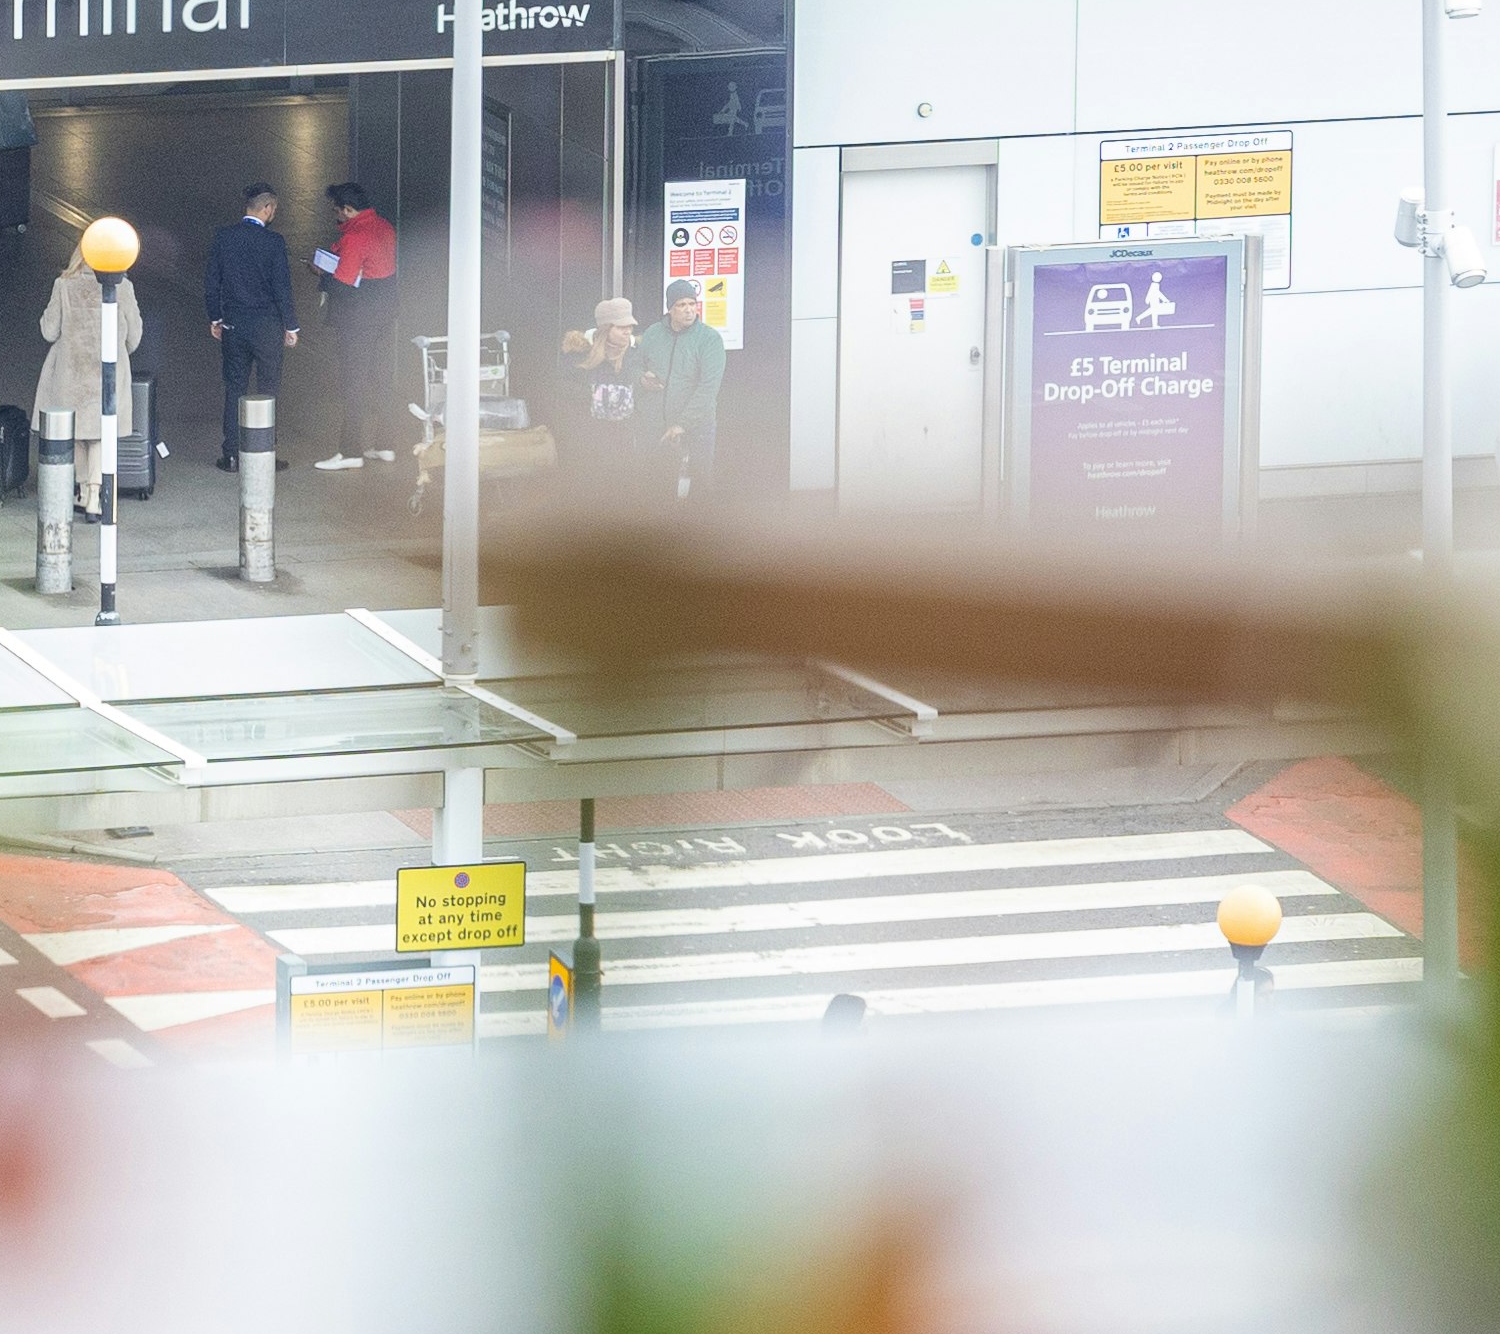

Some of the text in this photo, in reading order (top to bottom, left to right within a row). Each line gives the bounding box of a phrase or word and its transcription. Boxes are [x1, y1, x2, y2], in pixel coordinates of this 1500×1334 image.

[1125, 137, 1268, 153] Terminal 2 Passenger Drop Off
[1146, 164, 1160, 172] per
[1163, 161, 1182, 169] visit
[1109, 249, 1154, 258] JCDecaux
[1070, 352, 1187, 377] £5 Terminal
[1044, 376, 1214, 404] Drop-Off Charge
[1095, 506, 1156, 520] Heathrow
[551, 822, 975, 863] LOOK RIGHT
[416, 892, 506, 908] No stopping
[419, 910, 502, 926] at any time
[403, 925, 517, 943] except drop off
[315, 980, 353, 988] Terminal
[365, 977, 409, 985] Passenger
[413, 974, 434, 982] Drop
[436, 972, 451, 980] Off
[335, 999, 348, 1007] per
[352, 997, 370, 1005] visit
